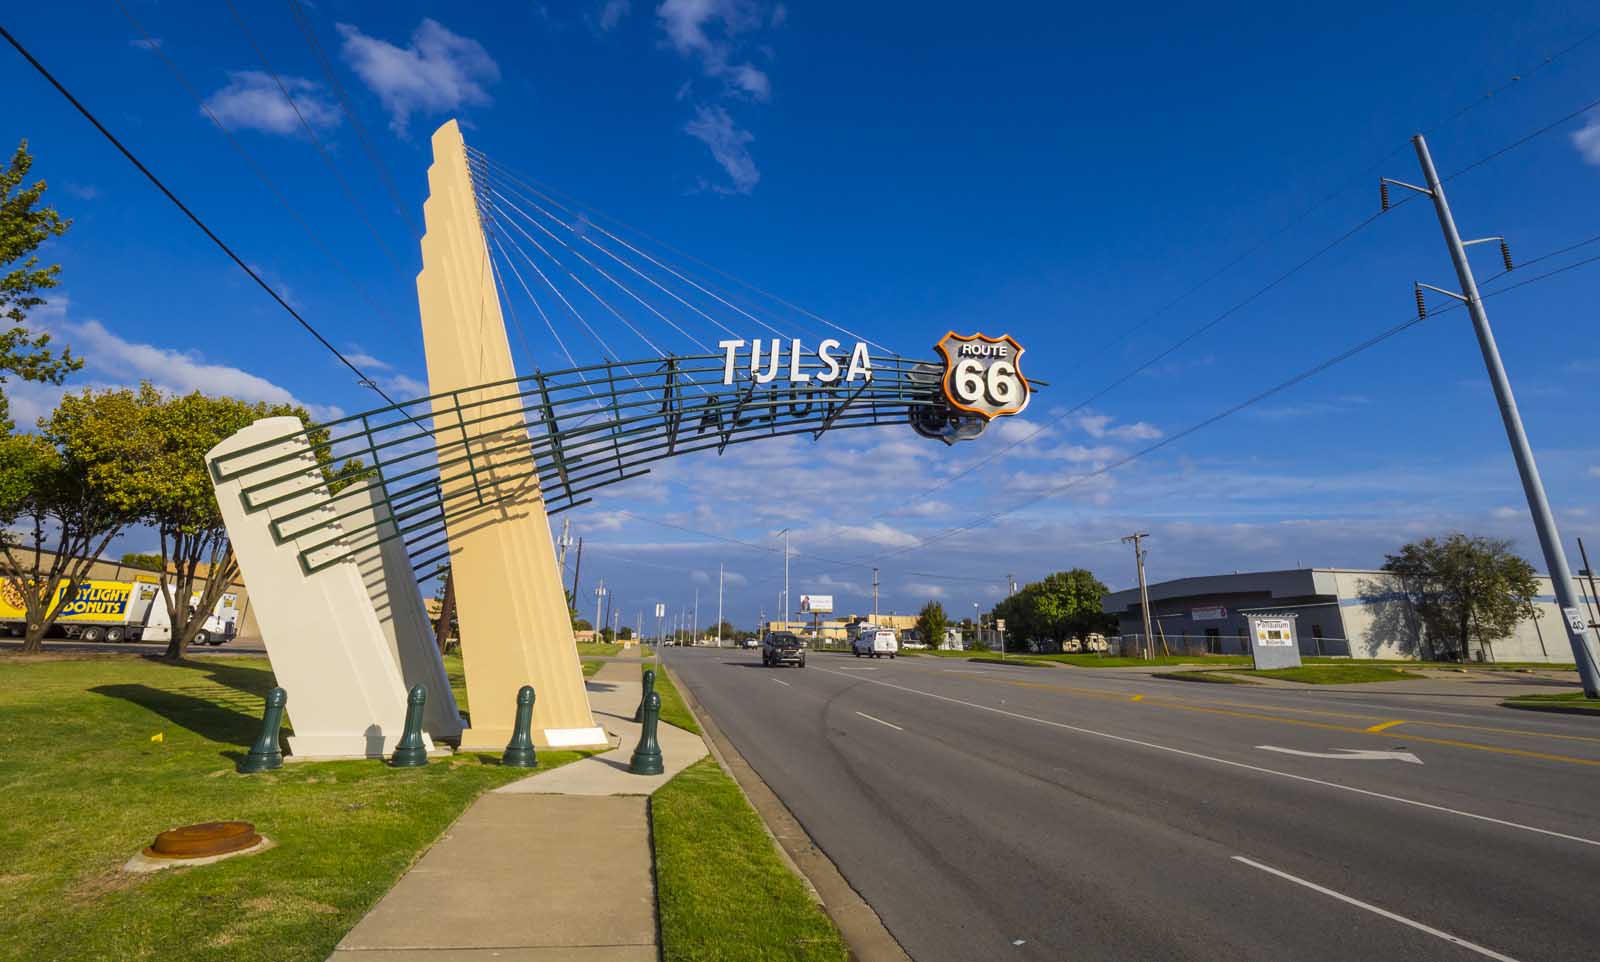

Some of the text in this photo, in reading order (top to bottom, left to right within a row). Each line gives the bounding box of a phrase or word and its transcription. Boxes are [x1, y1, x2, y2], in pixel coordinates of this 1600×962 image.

[962, 344, 1008, 356] ROUTE
[719, 338, 872, 385] TULSA
[955, 359, 1017, 404] 66
[61, 588, 129, 601] YLIGHT
[63, 601, 120, 613] DONUTS
[1573, 621, 1584, 630] 40
